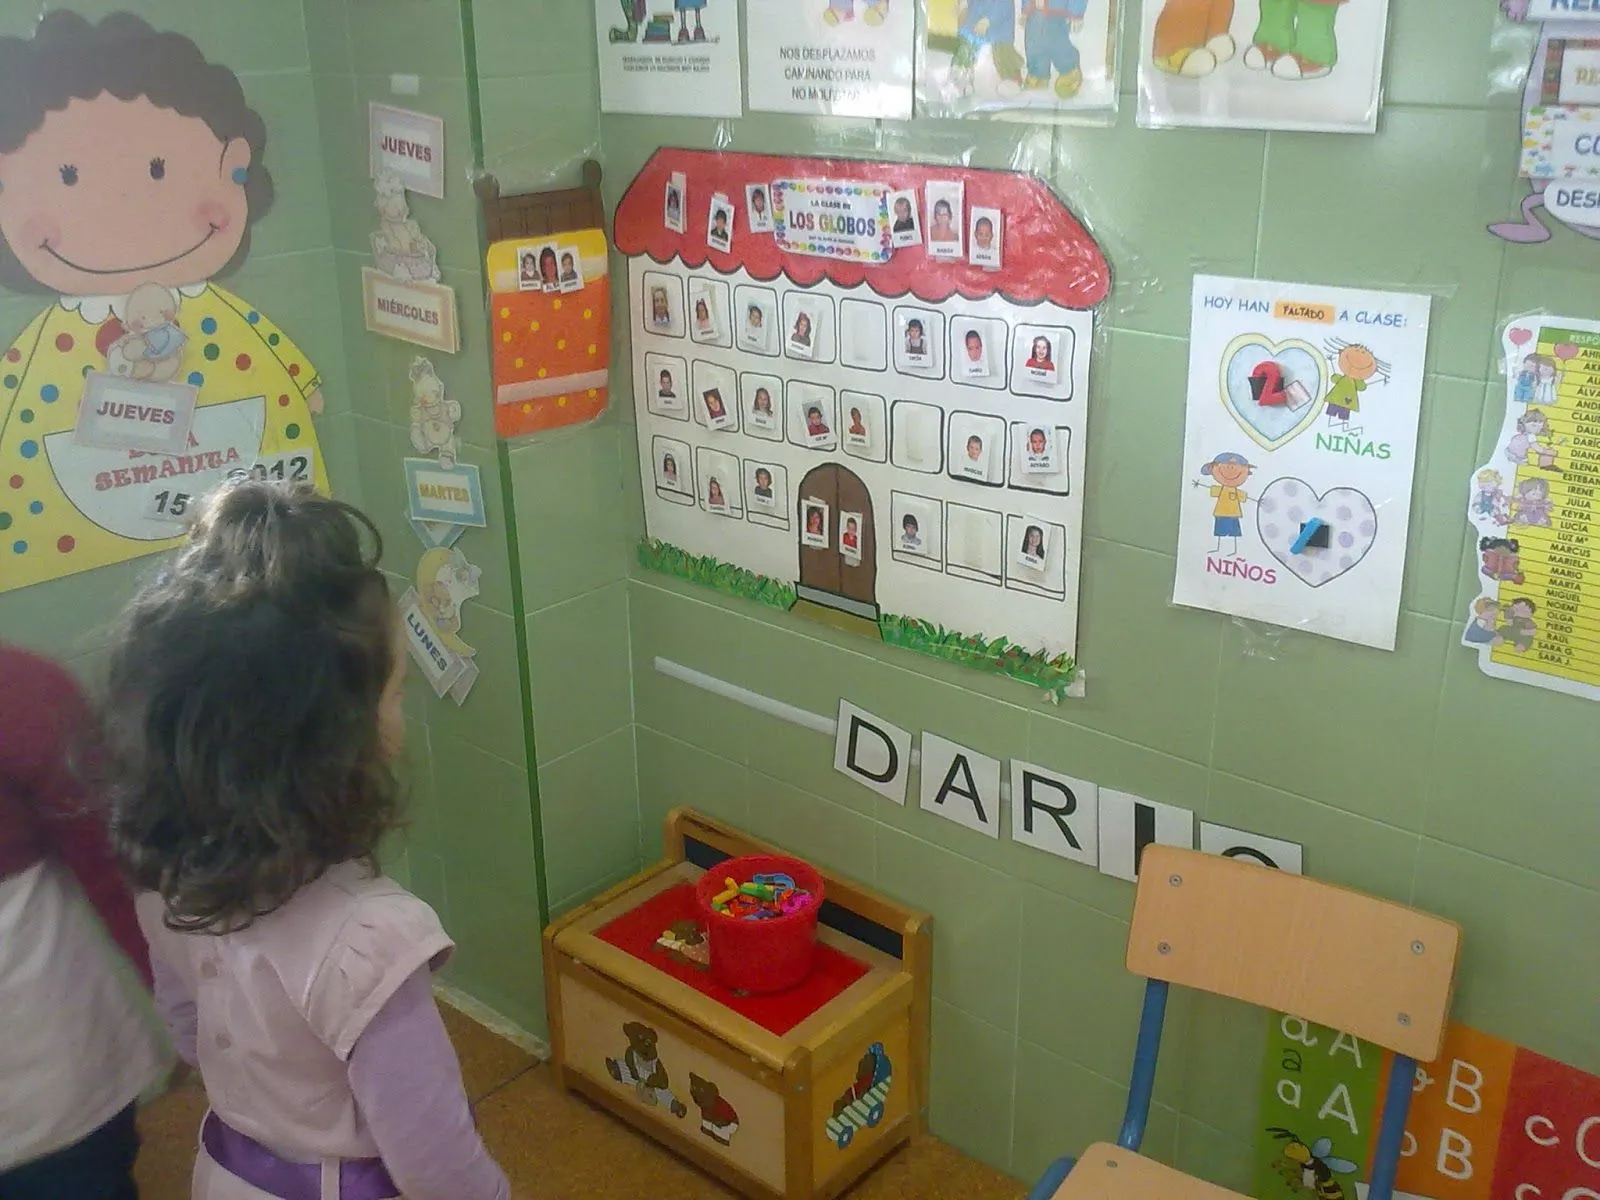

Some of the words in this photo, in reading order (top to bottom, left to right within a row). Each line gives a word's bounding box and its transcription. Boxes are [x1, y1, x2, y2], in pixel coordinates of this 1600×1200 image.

[780, 46, 800, 60] NOS
[792, 86, 806, 100] NO
[381, 135, 432, 162] JUEVES
[1557, 189, 1600, 208] DES
[789, 210, 814, 231] LOS
[819, 213, 876, 238] GLOBOS
[377, 297, 440, 326] MIÉRCOLES
[1204, 296, 1232, 310] HOY
[1238, 299, 1270, 313] HAN
[1283, 305, 1325, 321] FALTADO
[1339, 310, 1350, 322] A
[1355, 311, 1409, 328] CLASE:
[1252, 361, 1288, 407] 2
[96, 401, 176, 425] JUEVES
[1315, 432, 1392, 460] NIÑAS
[1569, 461, 1599, 473] ELENA
[418, 483, 470, 502] MARTES
[1567, 486, 1594, 497] IRENE
[154, 491, 191, 516] 15
[1561, 509, 1592, 521] KEYRA
[1550, 543, 1591, 558] MARCUS
[1206, 556, 1277, 584] NIÑOS
[1547, 554, 1590, 570] MARIELA
[1550, 567, 1583, 580] MARIO
[1548, 578, 1582, 591] MARTA
[1545, 589, 1580, 603] MIGUEL
[1547, 611, 1574, 623] OLGA
[406, 611, 448, 672] LUNES
[1538, 641, 1561, 653] SARA
[1538, 651, 1562, 664] SARA
[1446, 1058, 1484, 1114] B
[1317, 1083, 1359, 1135] A
[1436, 1127, 1474, 1181] B
